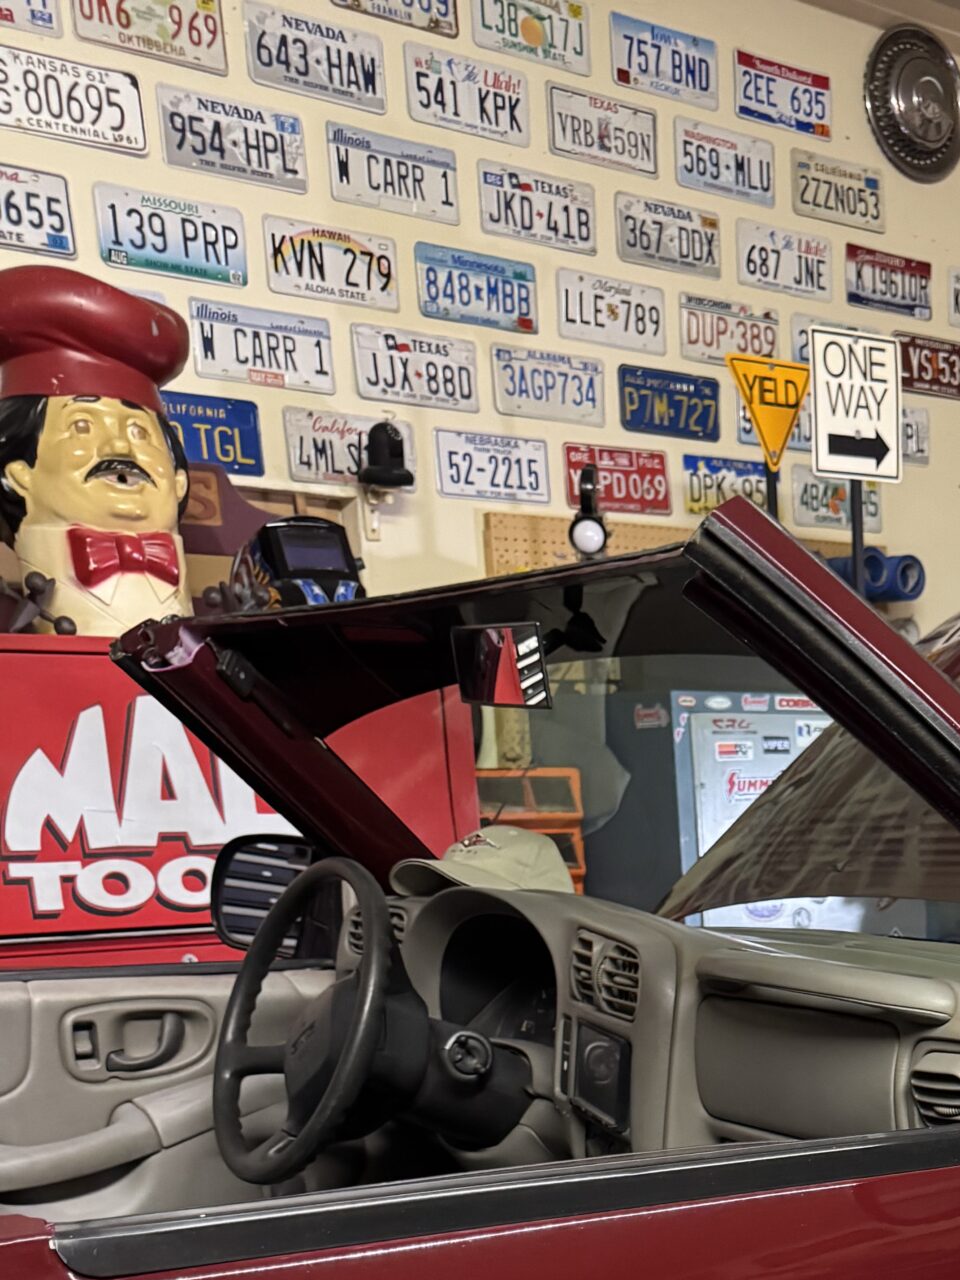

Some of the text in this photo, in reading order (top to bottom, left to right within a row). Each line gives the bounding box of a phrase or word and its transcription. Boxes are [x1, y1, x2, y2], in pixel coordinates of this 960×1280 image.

[168, 4, 218, 50] 969
[281, 14, 348, 44] NEVADA
[11, 51, 82, 80] KANSAS
[255, 30, 378, 96] 643 HAW
[623, 34, 710, 92] 757 BND
[22, 68, 126, 132] 80695
[196, 97, 266, 125] NEVADA
[415, 71, 461, 118] 541
[477, 86, 523, 134] KPK
[587, 95, 619, 115] TEXAS
[742, 70, 778, 108] 2EE
[790, 86, 826, 121] 635
[26, 117, 110, 142] CENTENNIAL
[169, 111, 299, 175] 954 HPL
[332, 127, 372, 150] Illinois
[335, 145, 350, 186] W
[366, 154, 426, 202] CARR
[682, 139, 721, 181] 569
[733, 153, 771, 193] MLU
[0, 188, 65, 233] 655
[140, 195, 200, 214] MISSOURI
[532, 179, 570, 199] TEXAS
[488, 189, 533, 232] JKD
[547, 201, 591, 242] 41B
[642, 201, 694, 223] NEVADA
[107, 202, 239, 267] 139 PRP
[311, 227, 352, 244] HAWAII
[624, 214, 716, 265] 367 DDX
[109, 249, 128, 265] AUG
[271, 232, 392, 293] KVN 279
[450, 253, 507, 276] Minnesota
[745, 244, 782, 281] 687
[793, 254, 827, 292] JNE
[195, 302, 239, 324] Illinois
[304, 282, 368, 302] ALOHA STATE
[425, 266, 531, 318] 848 MBB
[564, 287, 661, 337] LLE 789
[200, 321, 216, 361] W
[233, 326, 298, 373] CARR
[410, 338, 450, 357] TEXAS
[822, 340, 888, 384] ONE
[366, 352, 472, 400] JJX 88D
[501, 363, 597, 410] 3AGP734
[163, 401, 227, 419] ALIFORNIA
[825, 380, 888, 422] WAY
[192, 423, 256, 465] TGL
[311, 415, 370, 440] Califor
[464, 435, 520, 450] NEBRASKA
[447, 450, 540, 491] 52-2215
[726, 769, 776, 799] SUMM
[8, 856, 214, 912] TOO
